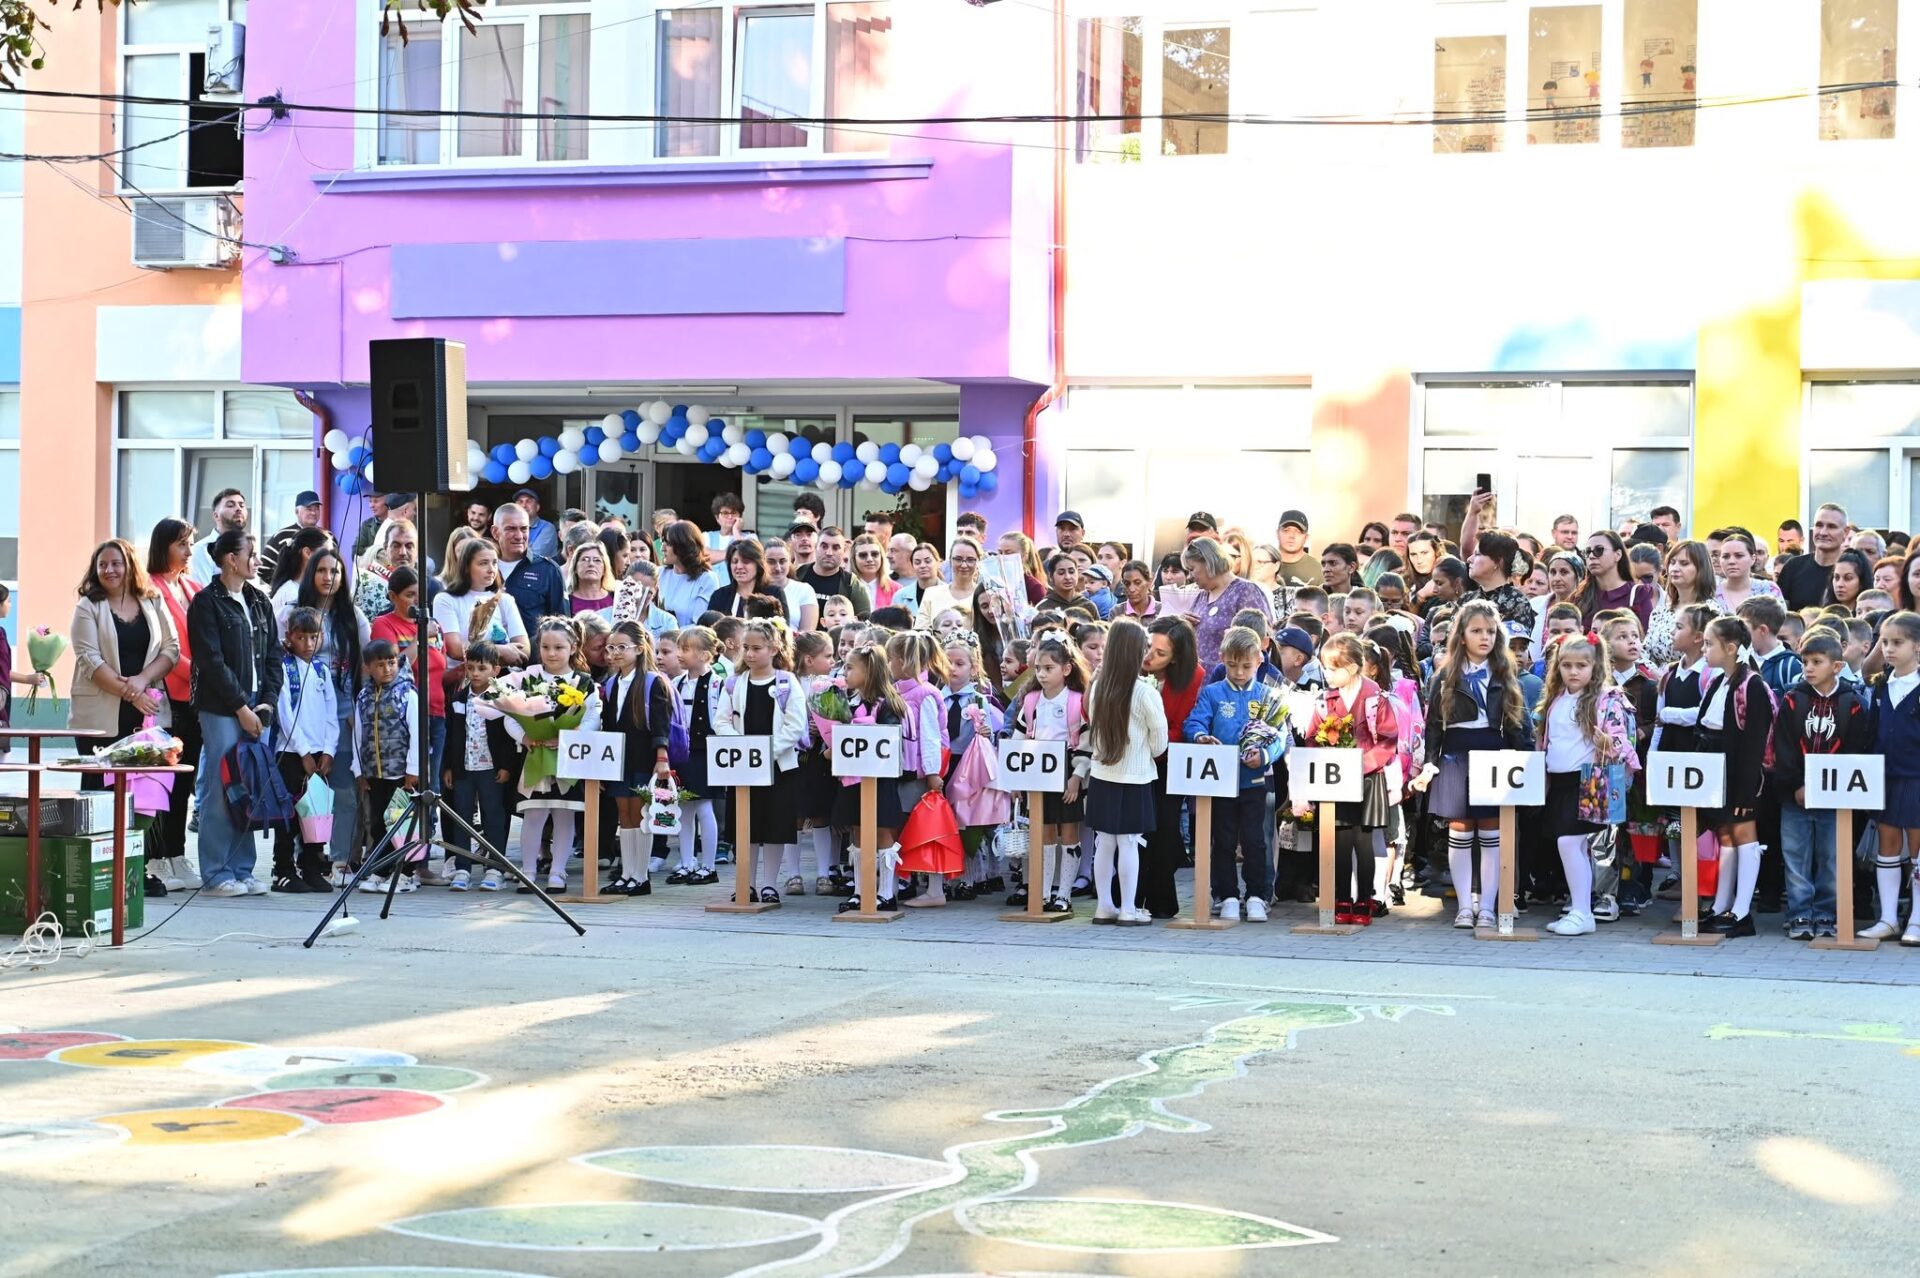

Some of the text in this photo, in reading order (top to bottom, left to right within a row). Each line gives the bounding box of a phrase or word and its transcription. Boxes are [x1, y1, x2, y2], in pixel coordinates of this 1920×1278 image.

[568, 743, 615, 762] CP A
[715, 747, 763, 769] CP B
[840, 737, 890, 759] CP C
[1005, 751, 1058, 774] CP D
[1186, 756, 1220, 781] I A
[1309, 761, 1341, 785] I B
[1491, 766, 1525, 789] I C
[1667, 766, 1704, 790] I D
[1821, 768, 1868, 793] II A
